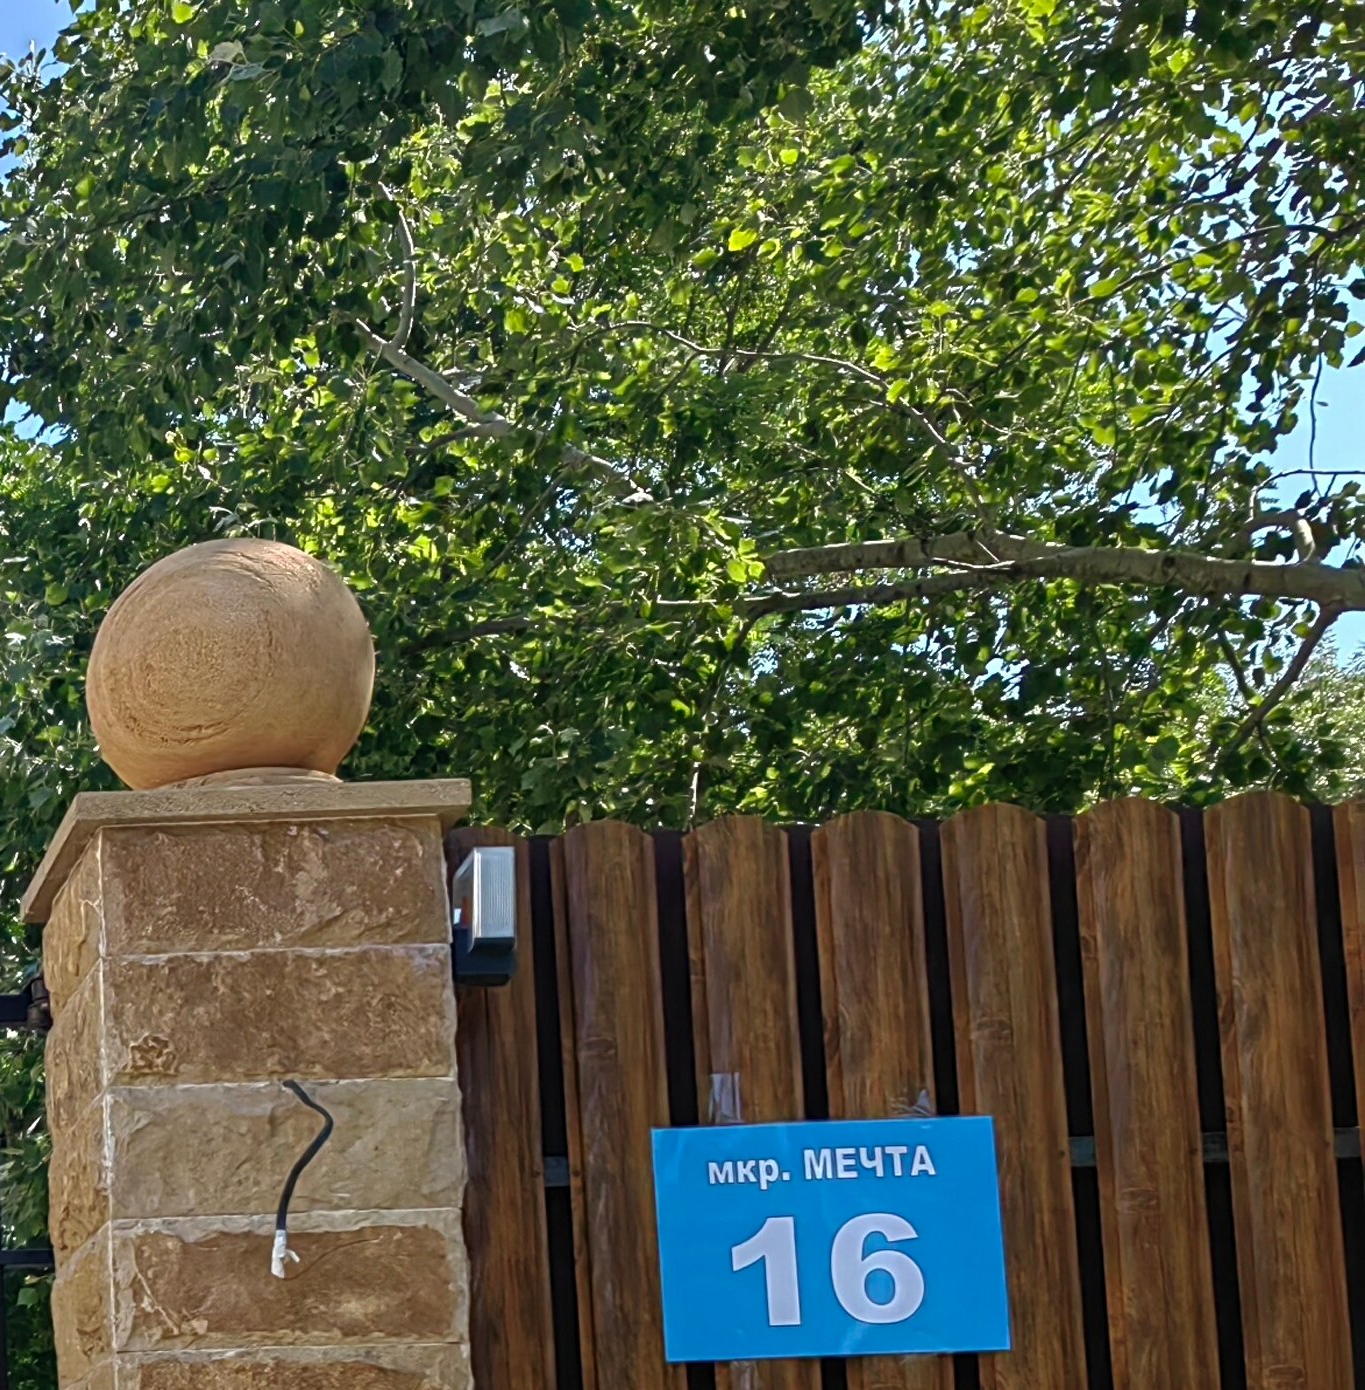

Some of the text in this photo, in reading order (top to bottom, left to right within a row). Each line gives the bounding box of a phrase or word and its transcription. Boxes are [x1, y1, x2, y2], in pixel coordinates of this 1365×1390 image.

[708, 1145, 937, 1190] мкр. МЕЧТА
[731, 1212, 925, 1327] 16
